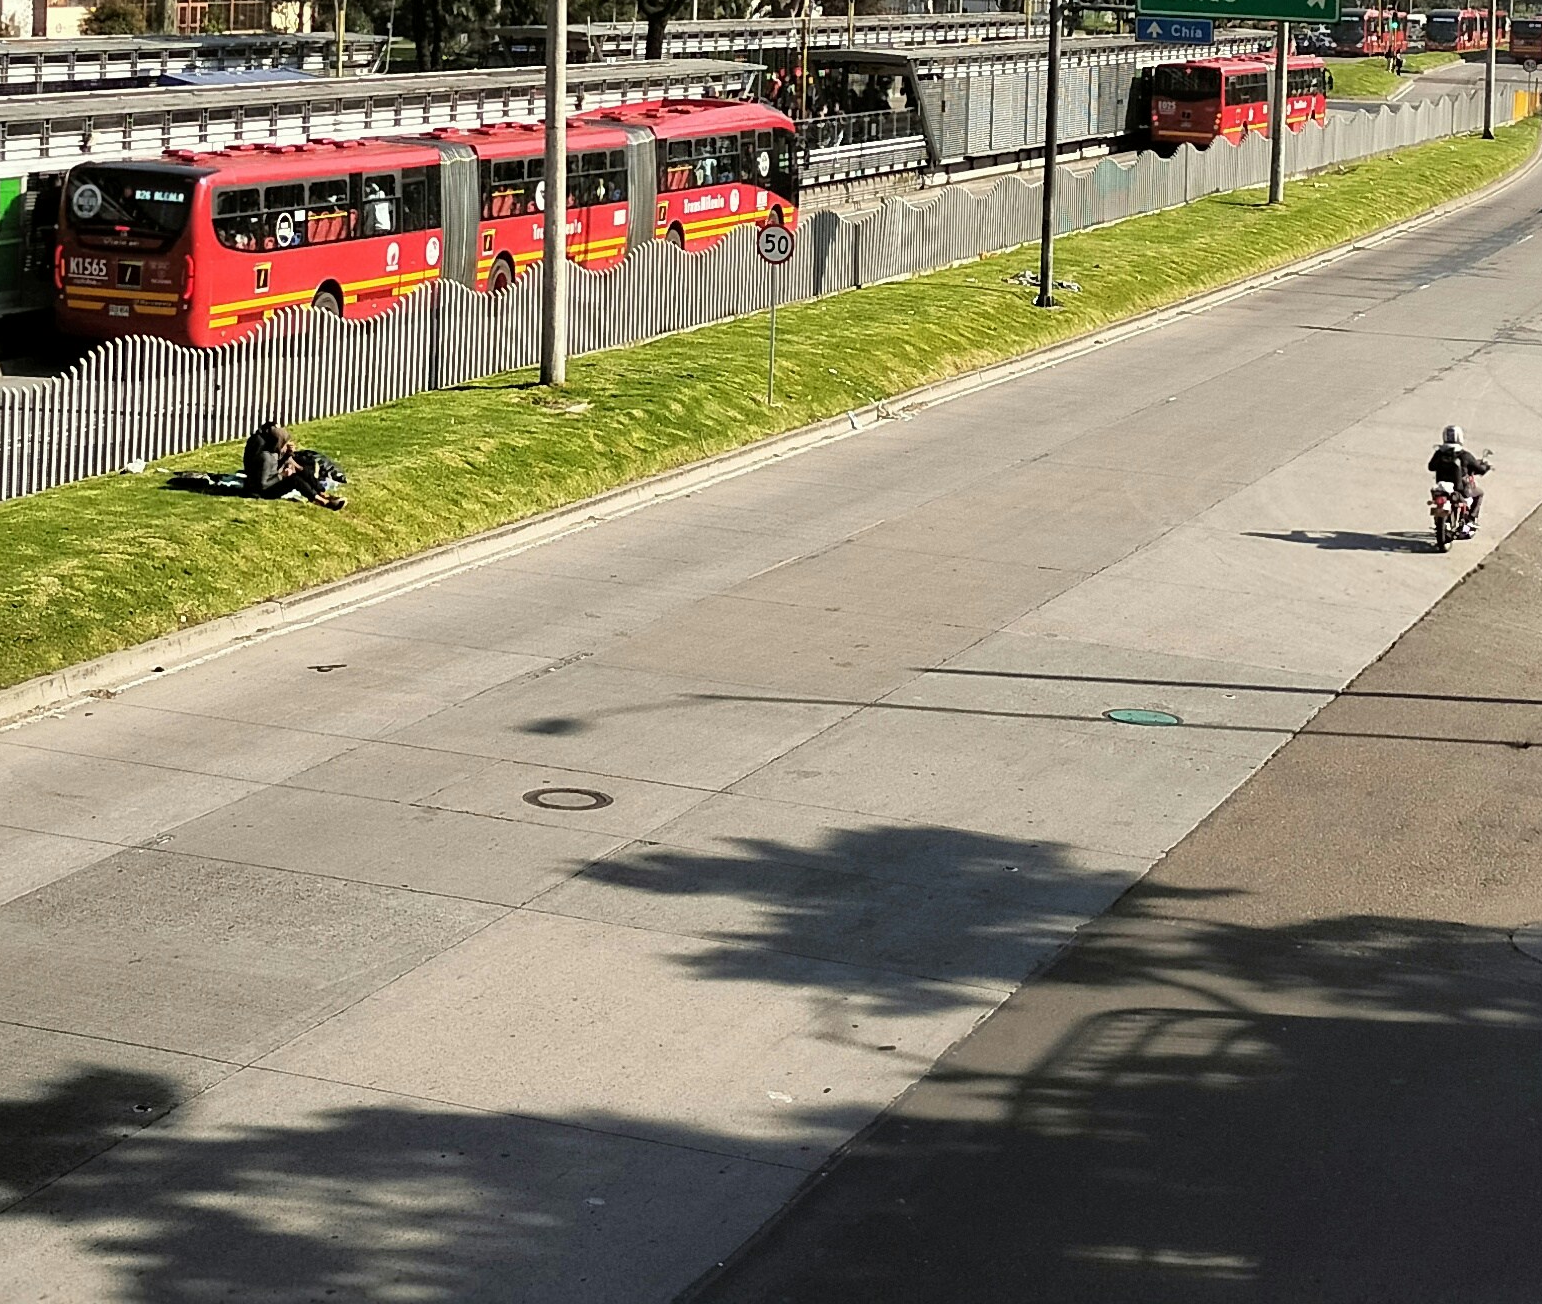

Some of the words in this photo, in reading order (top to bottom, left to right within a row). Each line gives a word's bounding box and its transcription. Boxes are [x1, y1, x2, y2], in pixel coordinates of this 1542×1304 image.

[1171, 24, 1203, 38] Chía
[764, 233, 789, 255] 50
[69, 257, 107, 275] K1565
